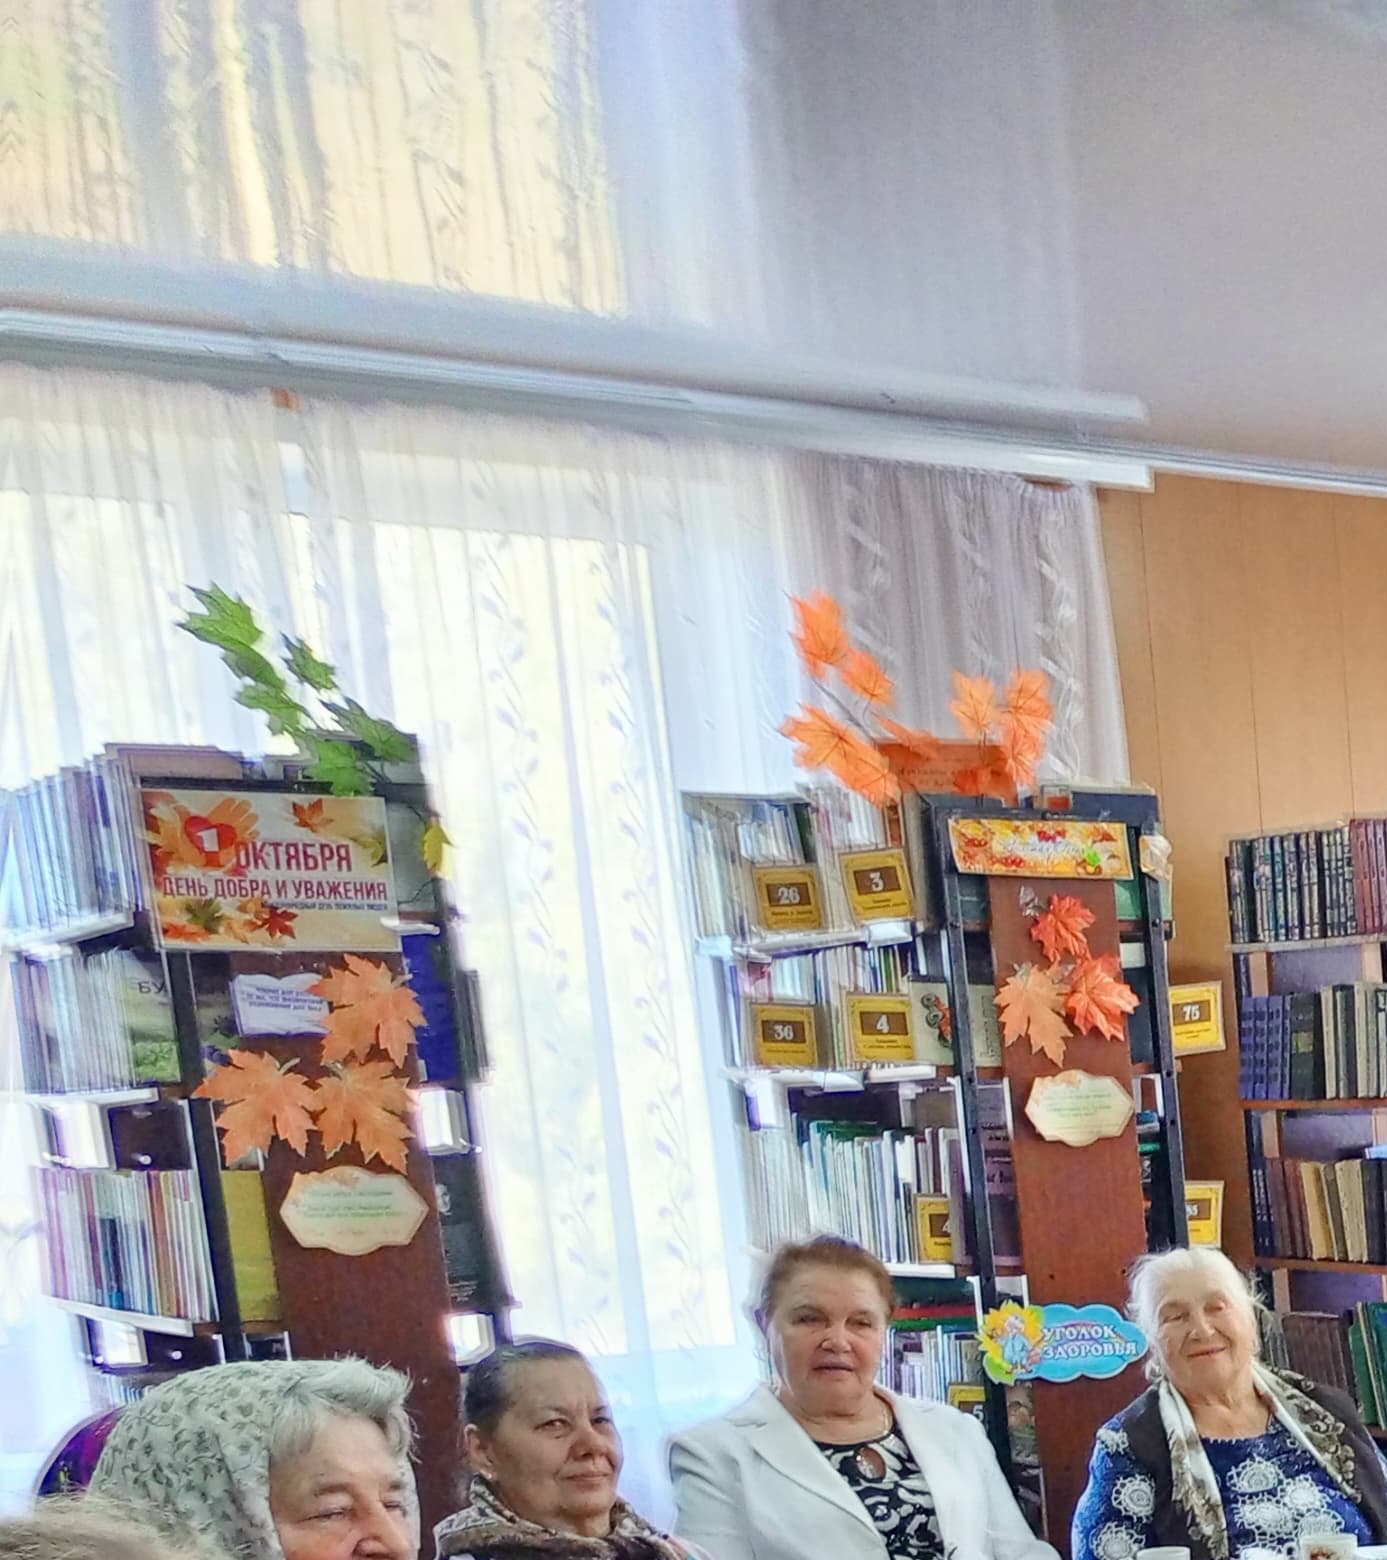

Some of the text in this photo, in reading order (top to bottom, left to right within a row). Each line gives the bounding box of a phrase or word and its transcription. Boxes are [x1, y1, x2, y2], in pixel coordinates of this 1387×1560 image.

[197, 828, 219, 852] 1
[235, 841, 353, 873] ОКТЯБРЯ
[163, 876, 388, 900] ДЕНЬ ДОБРА И УВАЖЕНИЯ
[869, 872, 885, 892] 3
[1183, 1004, 1200, 1022] 75
[876, 1015, 889, 1034] 4
[1042, 1324, 1117, 1341] УГОЛОК
[1043, 1341, 1136, 1359] ЗДОРОВЬЯ
[972, 1404, 984, 1421] 5
